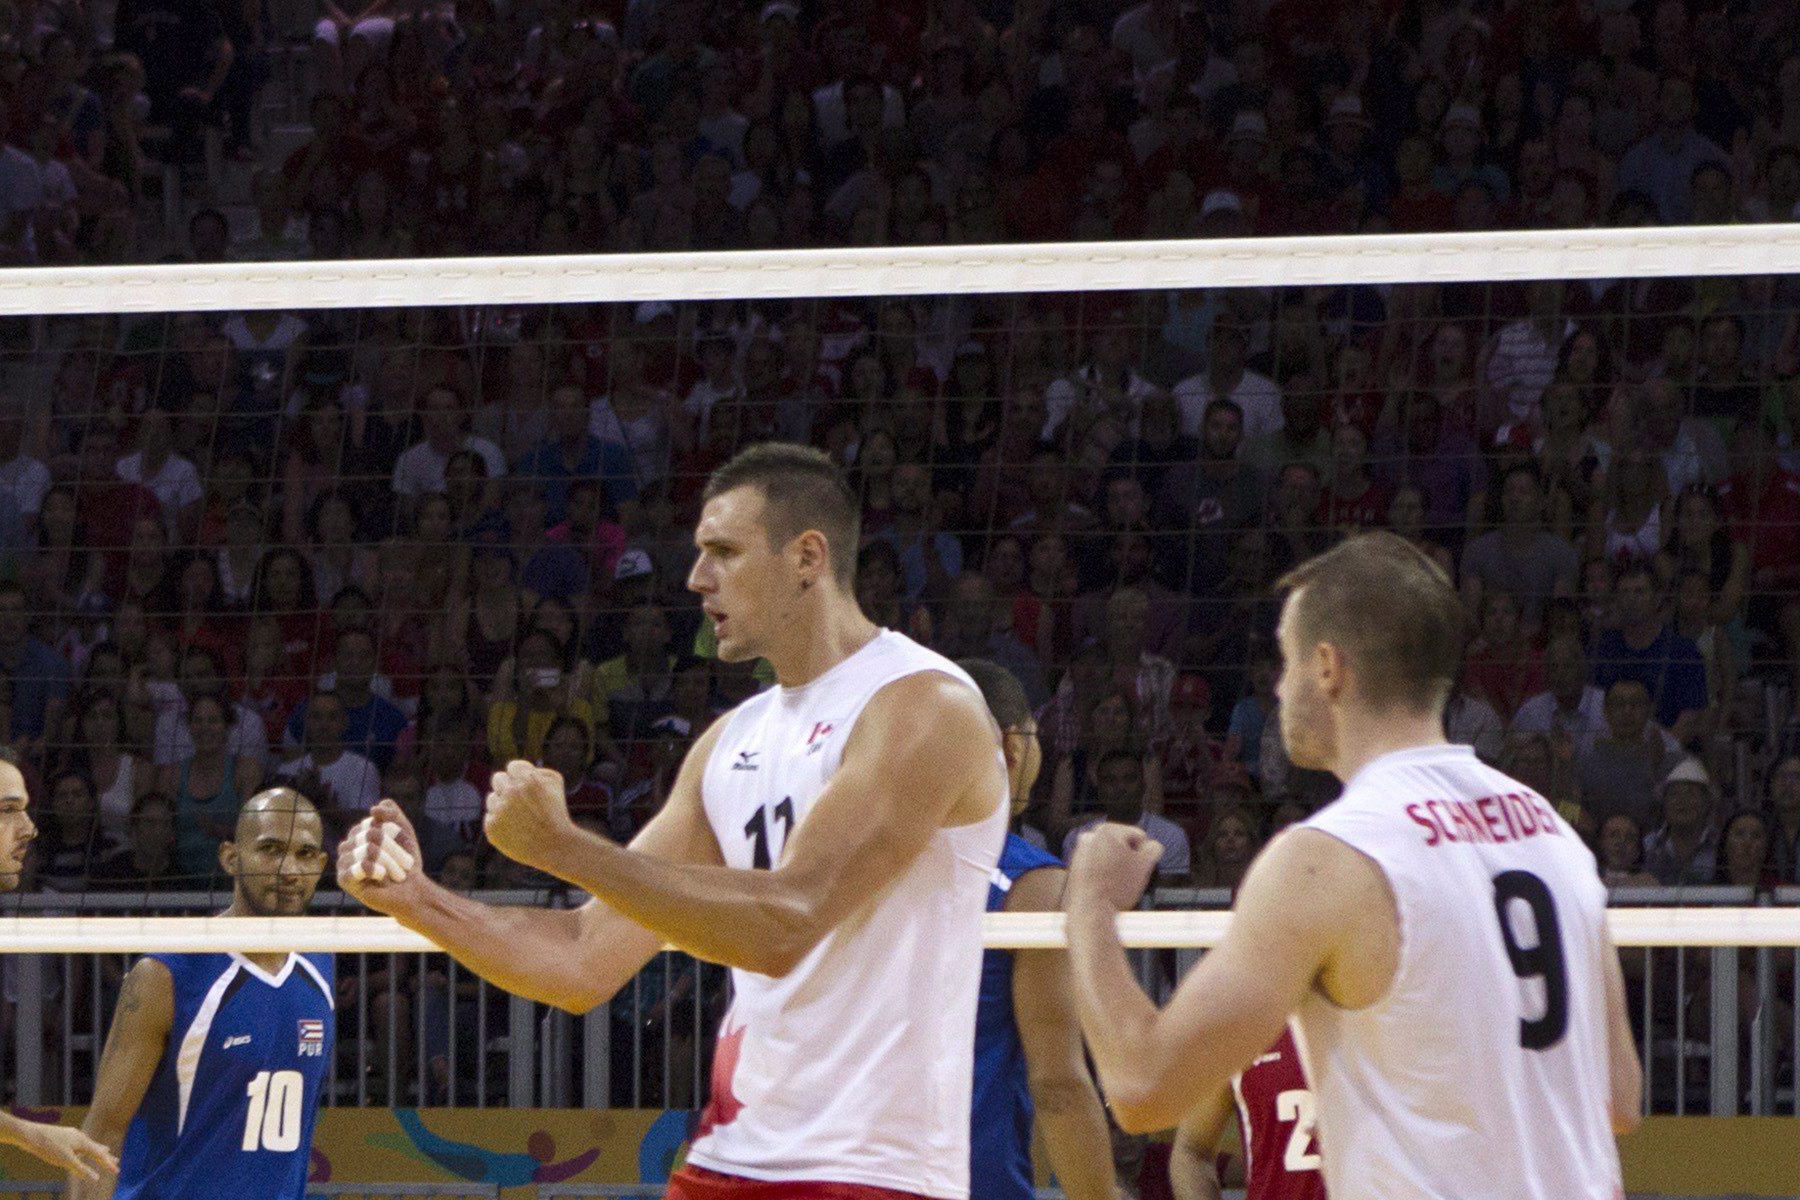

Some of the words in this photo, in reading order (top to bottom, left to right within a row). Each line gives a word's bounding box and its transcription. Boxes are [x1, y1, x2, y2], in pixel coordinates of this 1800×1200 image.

[1492, 869, 1570, 1051] 9
[298, 1042, 323, 1057] PUR
[242, 1070, 304, 1152] 10
